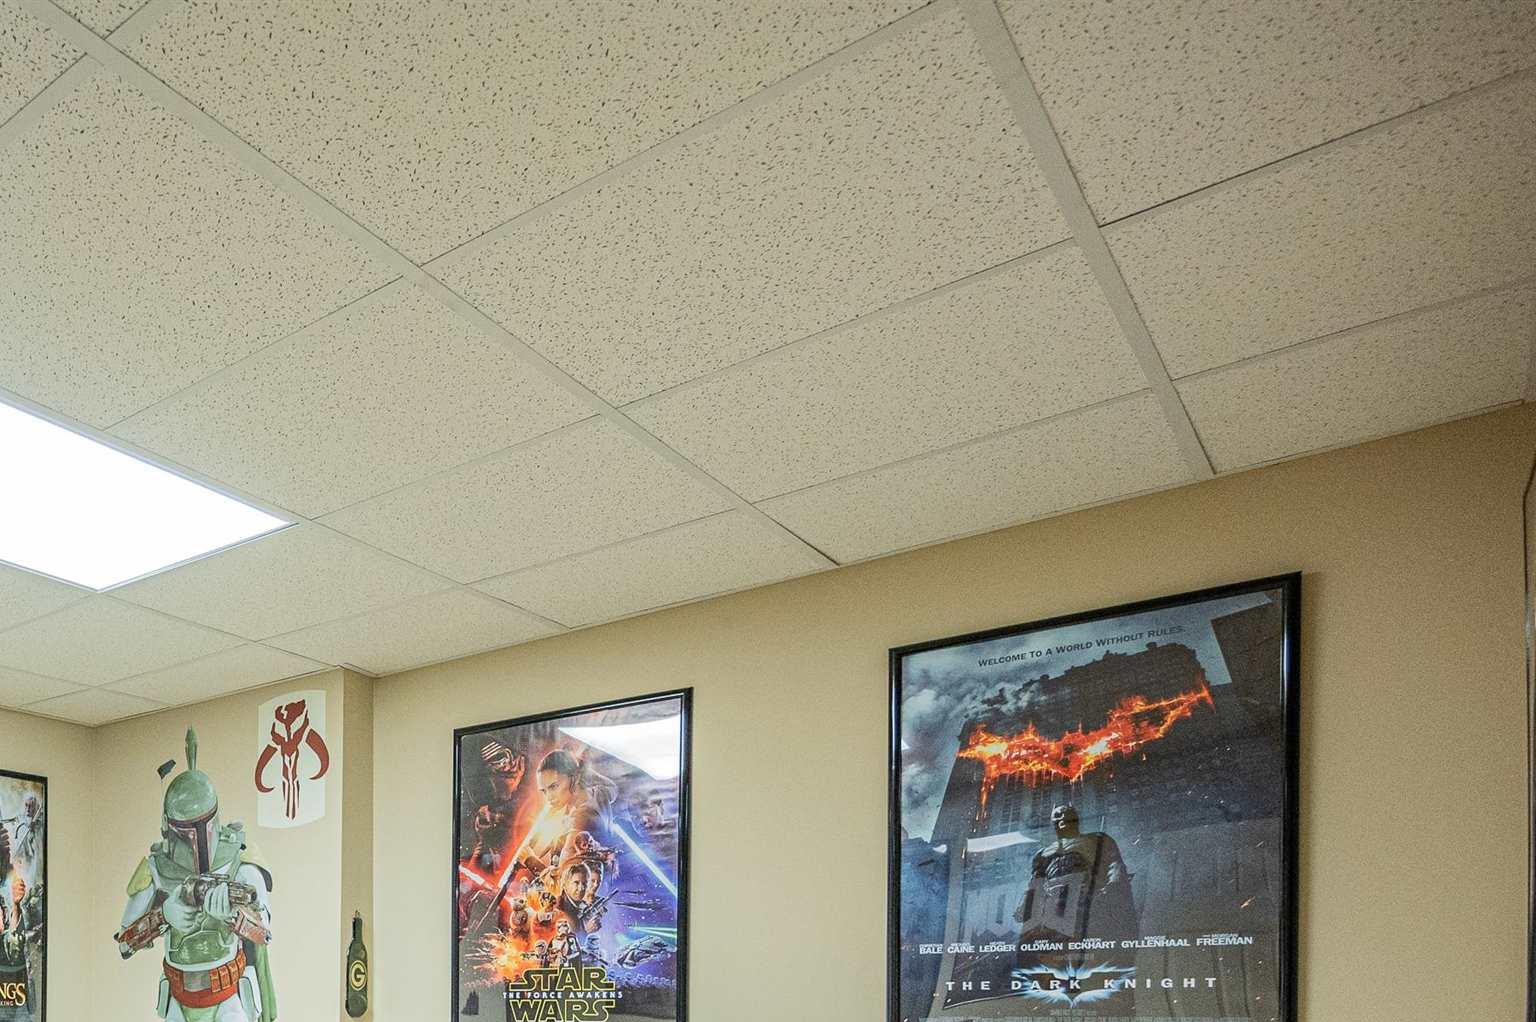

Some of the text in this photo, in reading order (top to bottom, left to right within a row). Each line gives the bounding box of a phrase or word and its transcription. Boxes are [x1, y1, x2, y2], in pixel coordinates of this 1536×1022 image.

[978, 652, 1027, 668] WELCOME
[1045, 648, 1053, 656] A
[1056, 641, 1093, 655] WORLD
[1096, 632, 1145, 648] WITHOUT
[920, 936, 1254, 955] BALE CAINE LEDGER OLDMAN ECKHART GYLLENHAAL FREEMAN
[509, 966, 616, 991] STAR
[945, 977, 1217, 991] THE DARK KNIGHT
[502, 990, 623, 999] THE FORCE AWAKENS
